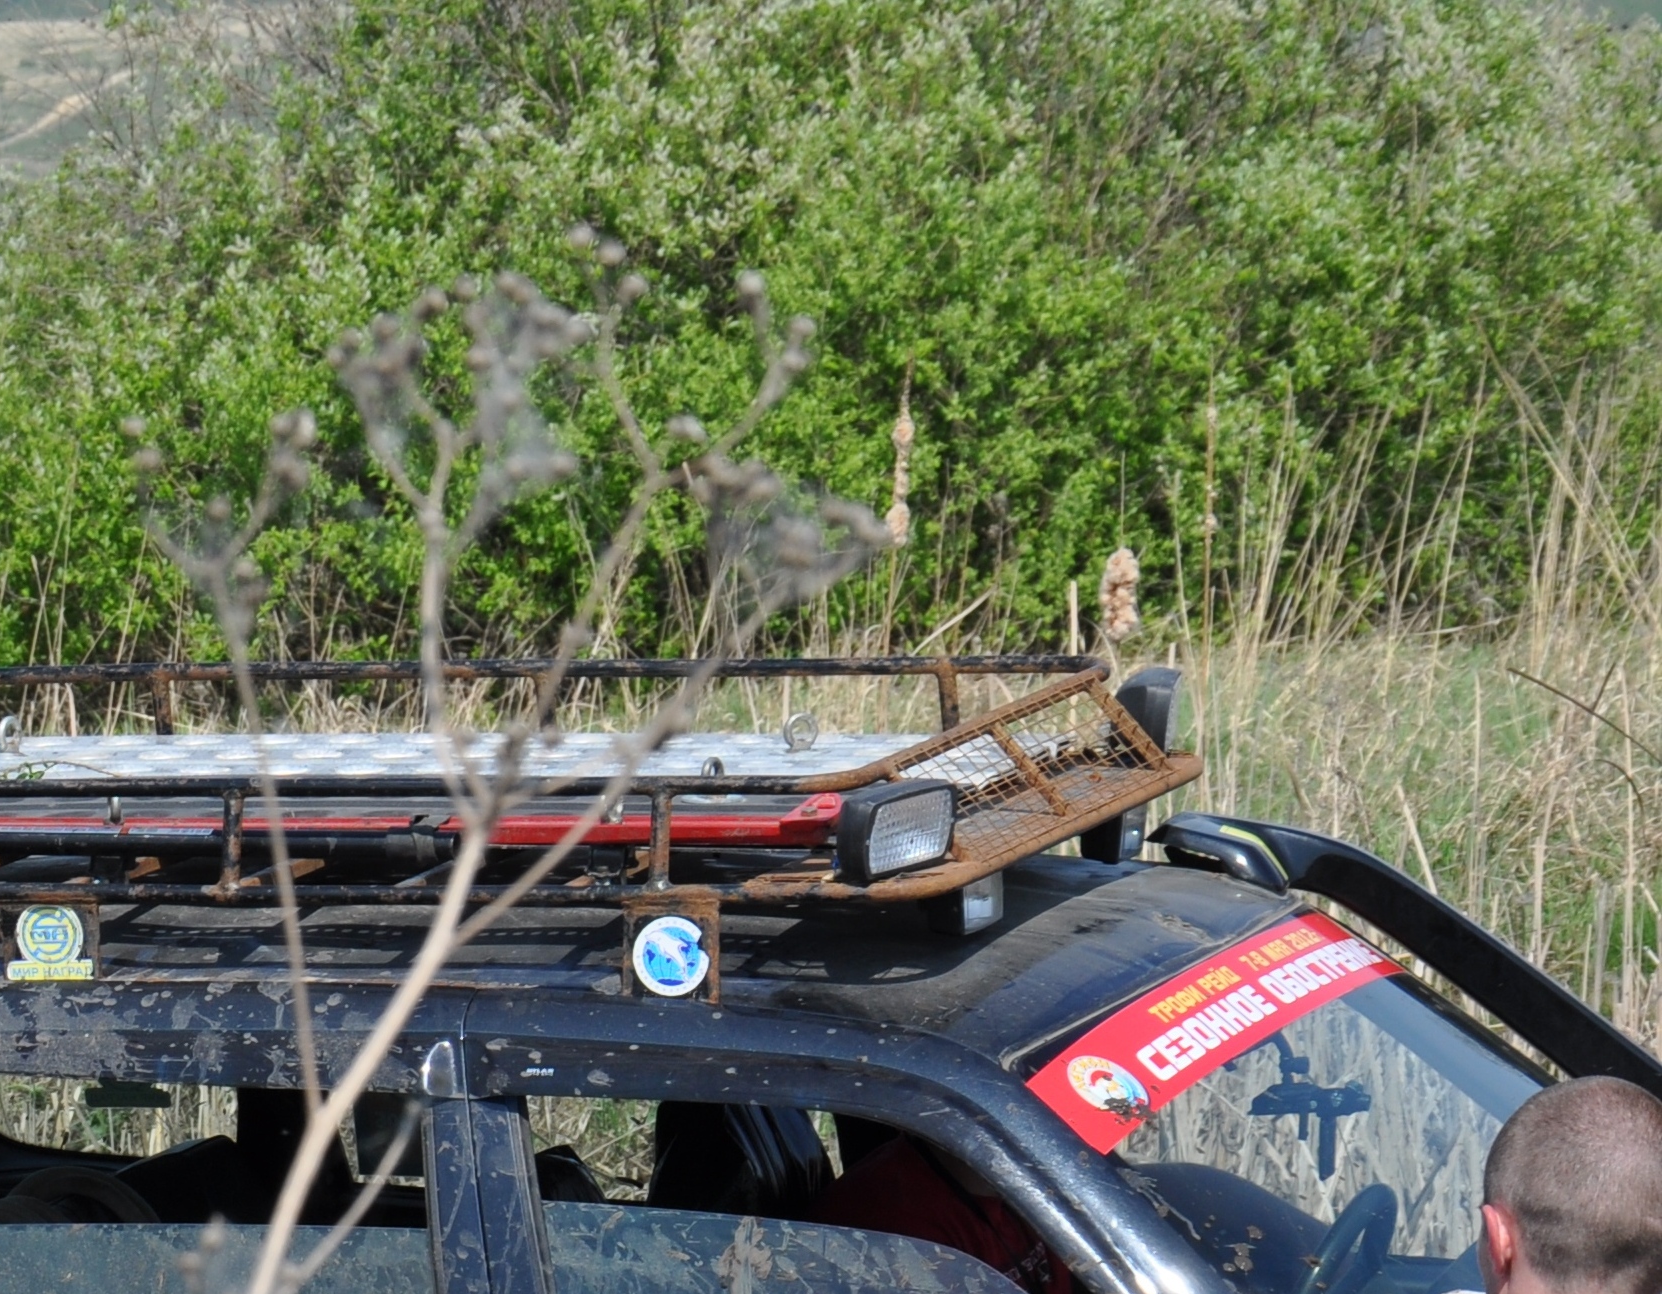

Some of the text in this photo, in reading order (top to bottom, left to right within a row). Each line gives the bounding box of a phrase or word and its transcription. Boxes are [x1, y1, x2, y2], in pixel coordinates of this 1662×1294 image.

[12, 967, 39, 978] МИР
[1136, 938, 1383, 1081] СЕЗОННОЕ ОБОСТРЕНИЕ
[1148, 986, 1206, 1024] ТРОФИ
[1198, 966, 1242, 996] РЕЙД
[1261, 942, 1291, 962] МАЯ
